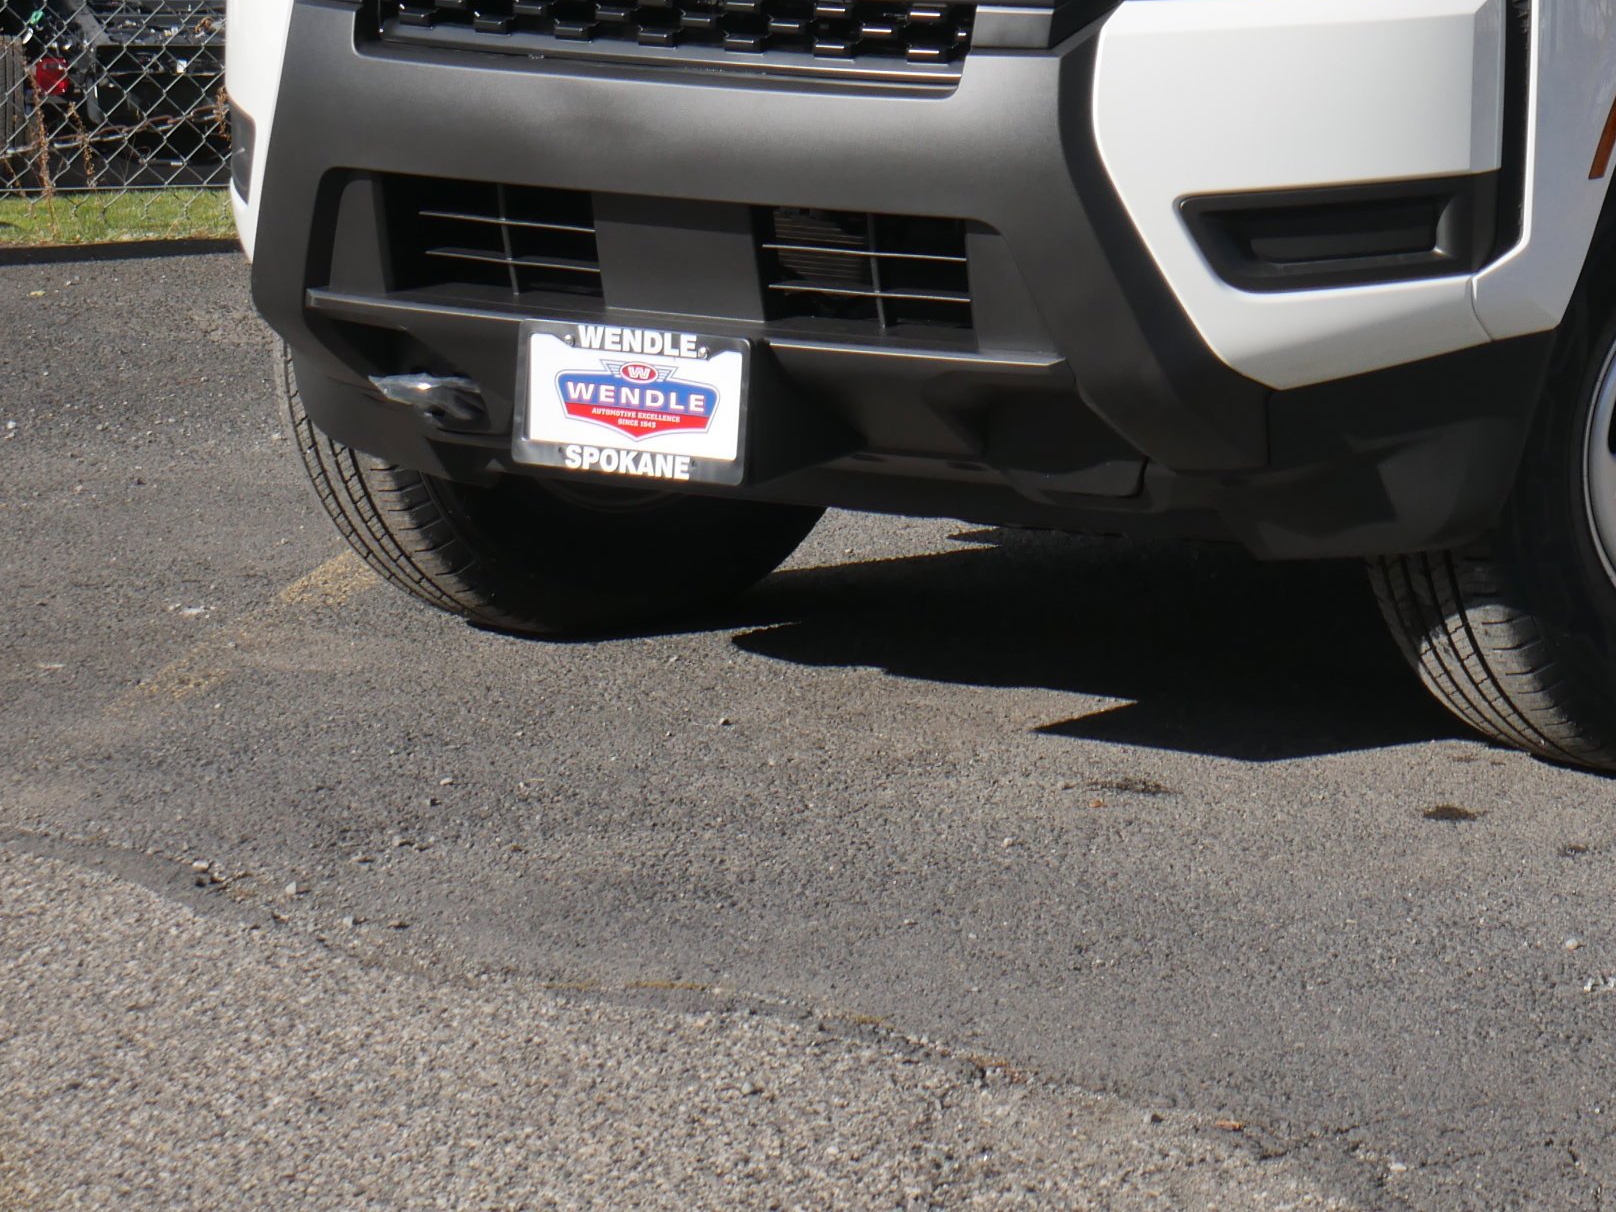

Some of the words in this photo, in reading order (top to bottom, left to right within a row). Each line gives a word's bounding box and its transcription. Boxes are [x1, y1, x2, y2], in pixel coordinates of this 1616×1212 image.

[578, 325, 697, 358] WENDLE
[567, 381, 705, 411] WENDLE
[592, 407, 636, 419] AUTOMOTIVE
[637, 412, 680, 423] EXCELLENCE
[618, 418, 639, 427] SINCE
[565, 444, 690, 481] SPOKANE
